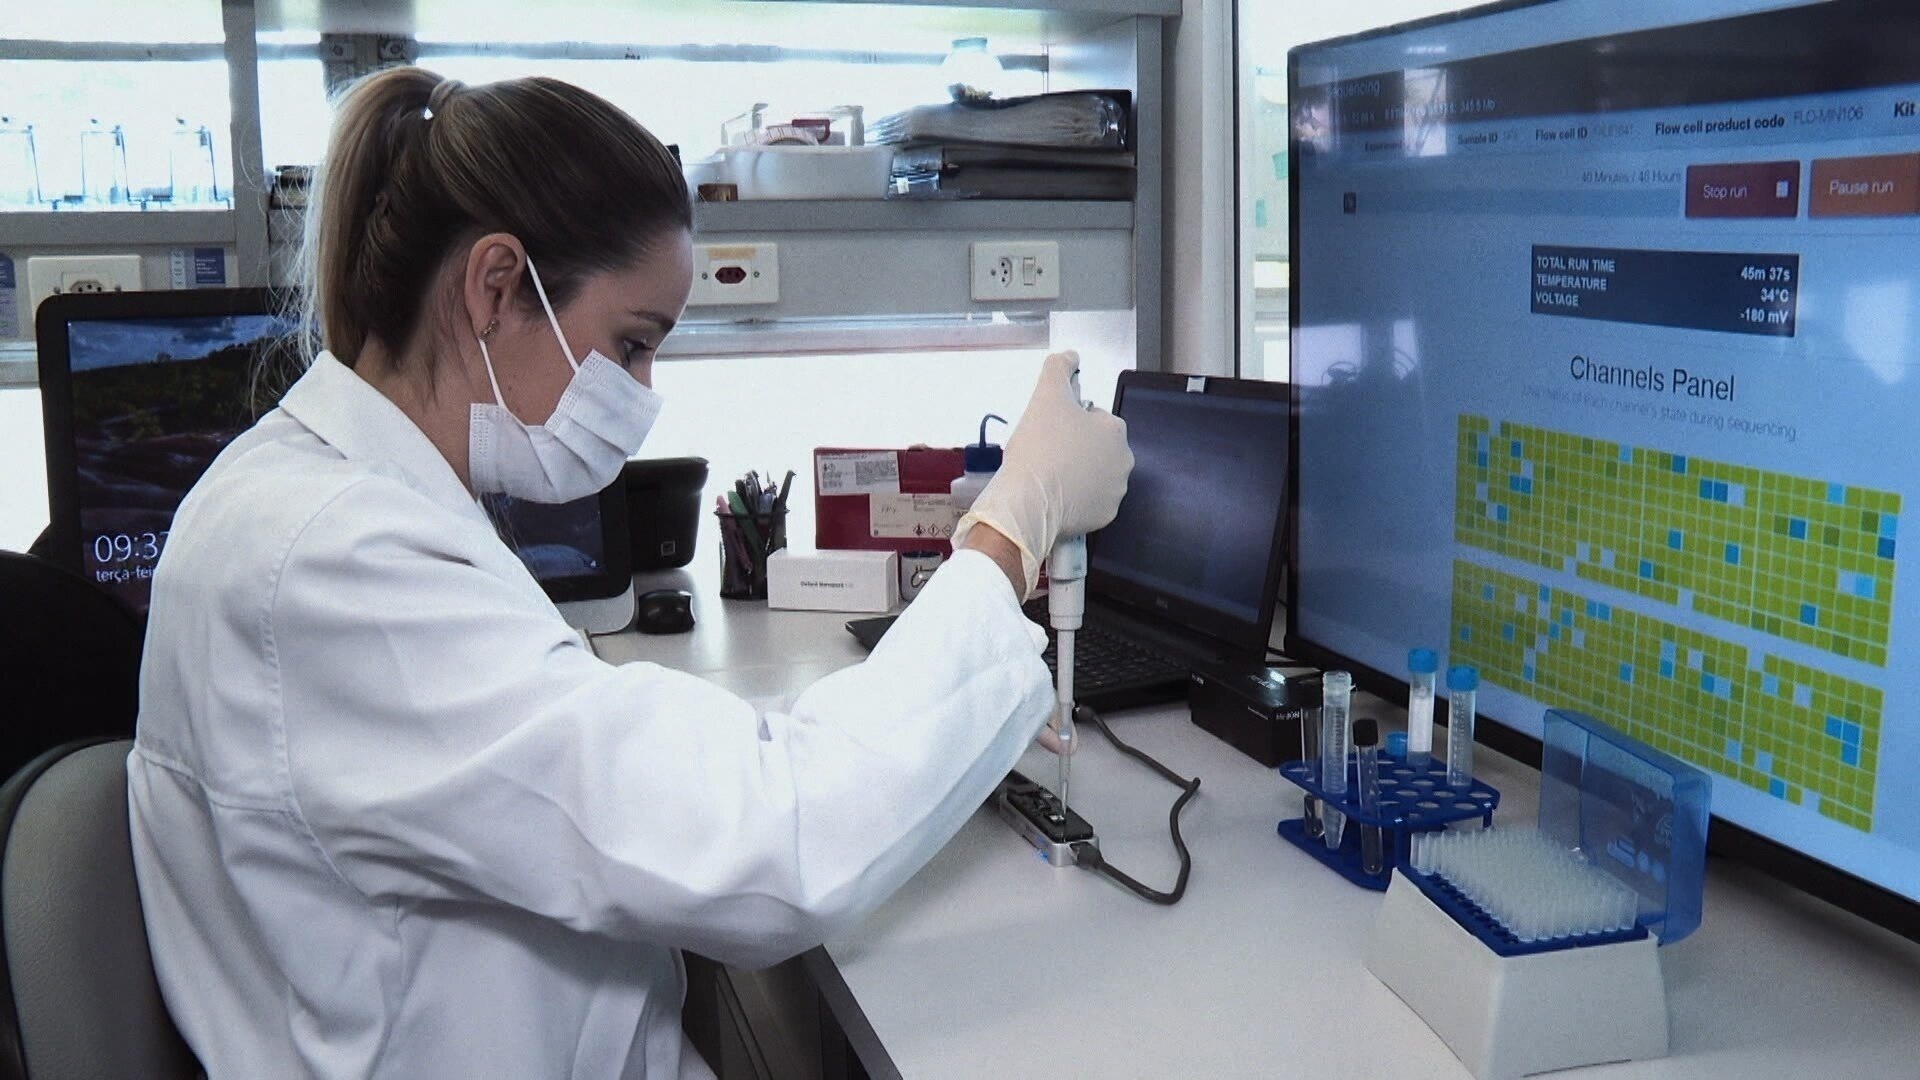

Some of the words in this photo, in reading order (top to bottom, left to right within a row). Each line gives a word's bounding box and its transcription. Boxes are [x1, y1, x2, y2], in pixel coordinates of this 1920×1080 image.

[1894, 101, 1915, 118] Kit
[1655, 122, 1681, 135] Flow
[1683, 120, 1703, 134] cell
[1705, 118, 1751, 134] product
[1755, 114, 1785, 129] code
[1488, 131, 1498, 143] ID
[1535, 128, 1557, 141] Flow
[1559, 127, 1576, 140] cell
[1578, 126, 1588, 139] ID
[1653, 168, 1682, 182] Hours
[1703, 184, 1727, 200] Stop
[1730, 186, 1747, 198] run
[1829, 179, 1868, 195] Pause
[1872, 180, 1894, 194] run
[1537, 256, 1566, 270] TOTAL
[1568, 257, 1588, 272] RUN
[1592, 258, 1615, 273] TIME
[1537, 273, 1607, 291] TEMPERATURE
[1741, 266, 1766, 281] 45m
[1769, 266, 1791, 282] 37s
[1535, 291, 1579, 307] VOLTAGE
[1760, 288, 1789, 303] 34°C
[1740, 308, 1765, 323] -180
[1768, 309, 1789, 324] mV
[1570, 355, 1665, 393] Channels
[1672, 368, 1735, 402] Panel
[1660, 406, 1687, 420] state
[1689, 410, 1724, 430] during
[1727, 416, 1797, 442] sequencing
[96, 565, 154, 583] terça-fei
